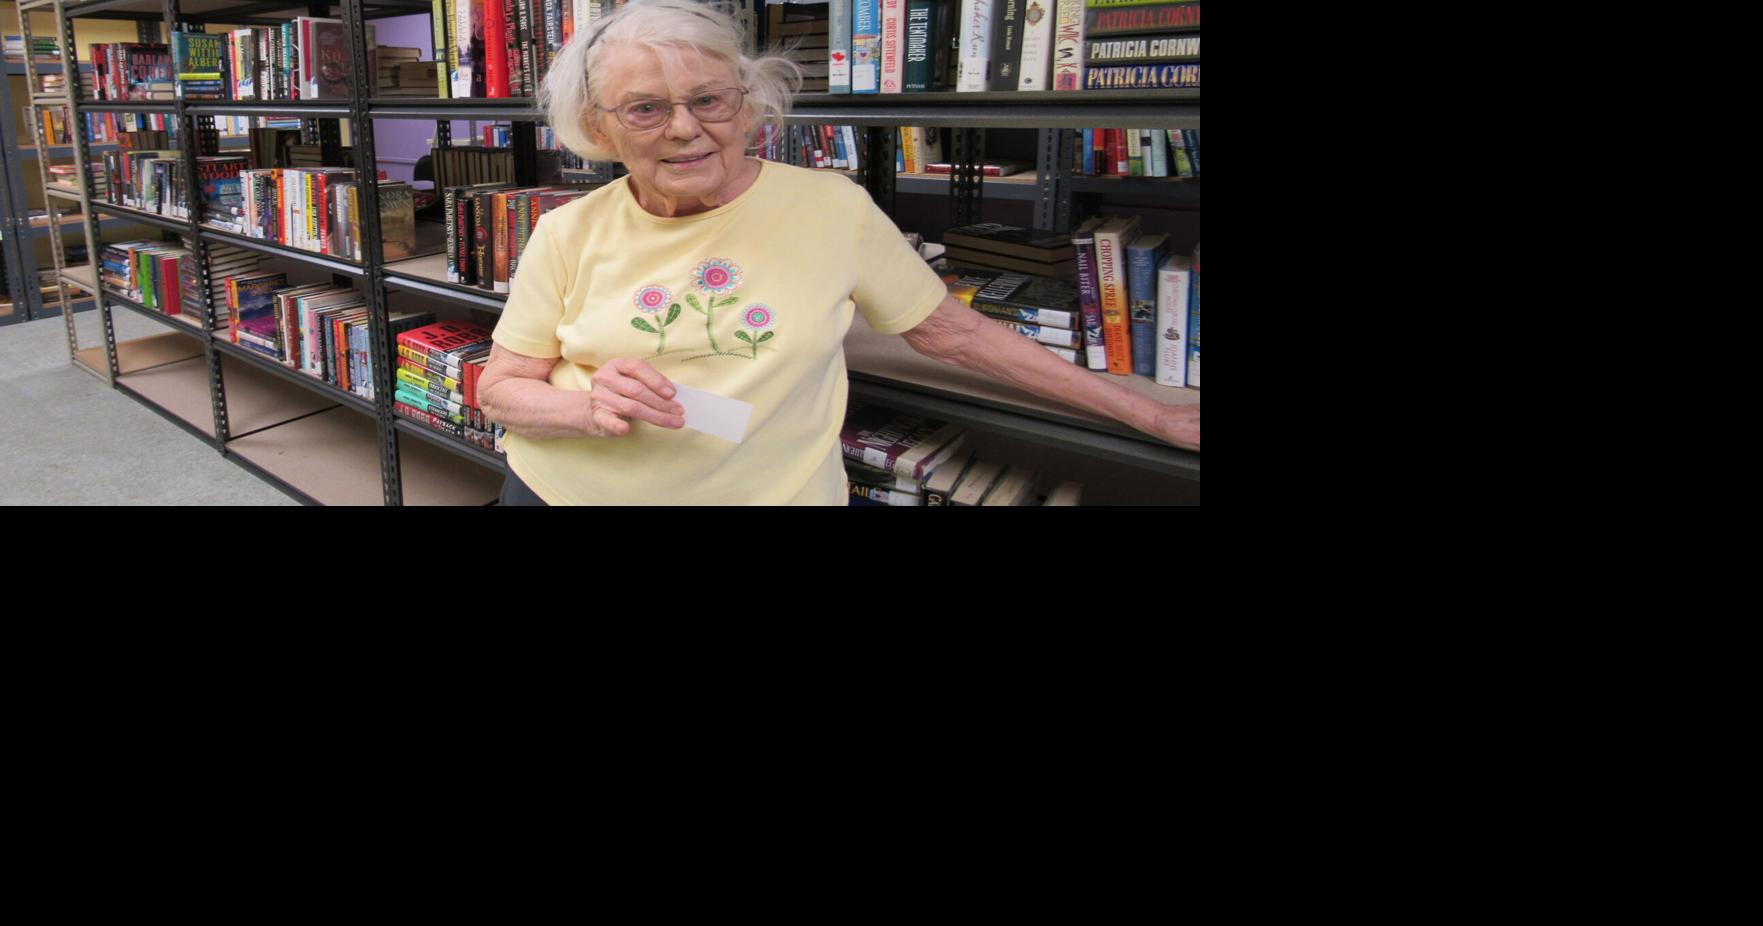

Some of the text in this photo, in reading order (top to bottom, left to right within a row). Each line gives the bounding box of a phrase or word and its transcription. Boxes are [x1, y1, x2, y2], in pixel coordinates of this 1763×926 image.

[545, 12, 554, 45] FAIRSTEIN
[886, 18, 897, 39] CURTIS
[1096, 9, 1155, 32] PATRICIA
[908, 8, 929, 62] THE TENTMAKER
[885, 40, 897, 74] SITTENFELD
[1091, 37, 1200, 59] PATRICIA CORNW
[188, 58, 219, 67] ALBER
[1087, 65, 1200, 89] PATRICIA COR
[199, 171, 239, 181] WOOD
[445, 192, 454, 208] SARA
[530, 200, 538, 223] ANNE
[445, 208, 455, 234] PARETSKY
[518, 200, 526, 224] ANNE
[1078, 252, 1091, 295] NAIL BITER
[1100, 239, 1117, 311] CHOPPING SPREE
[432, 417, 457, 431] PAYBACK
